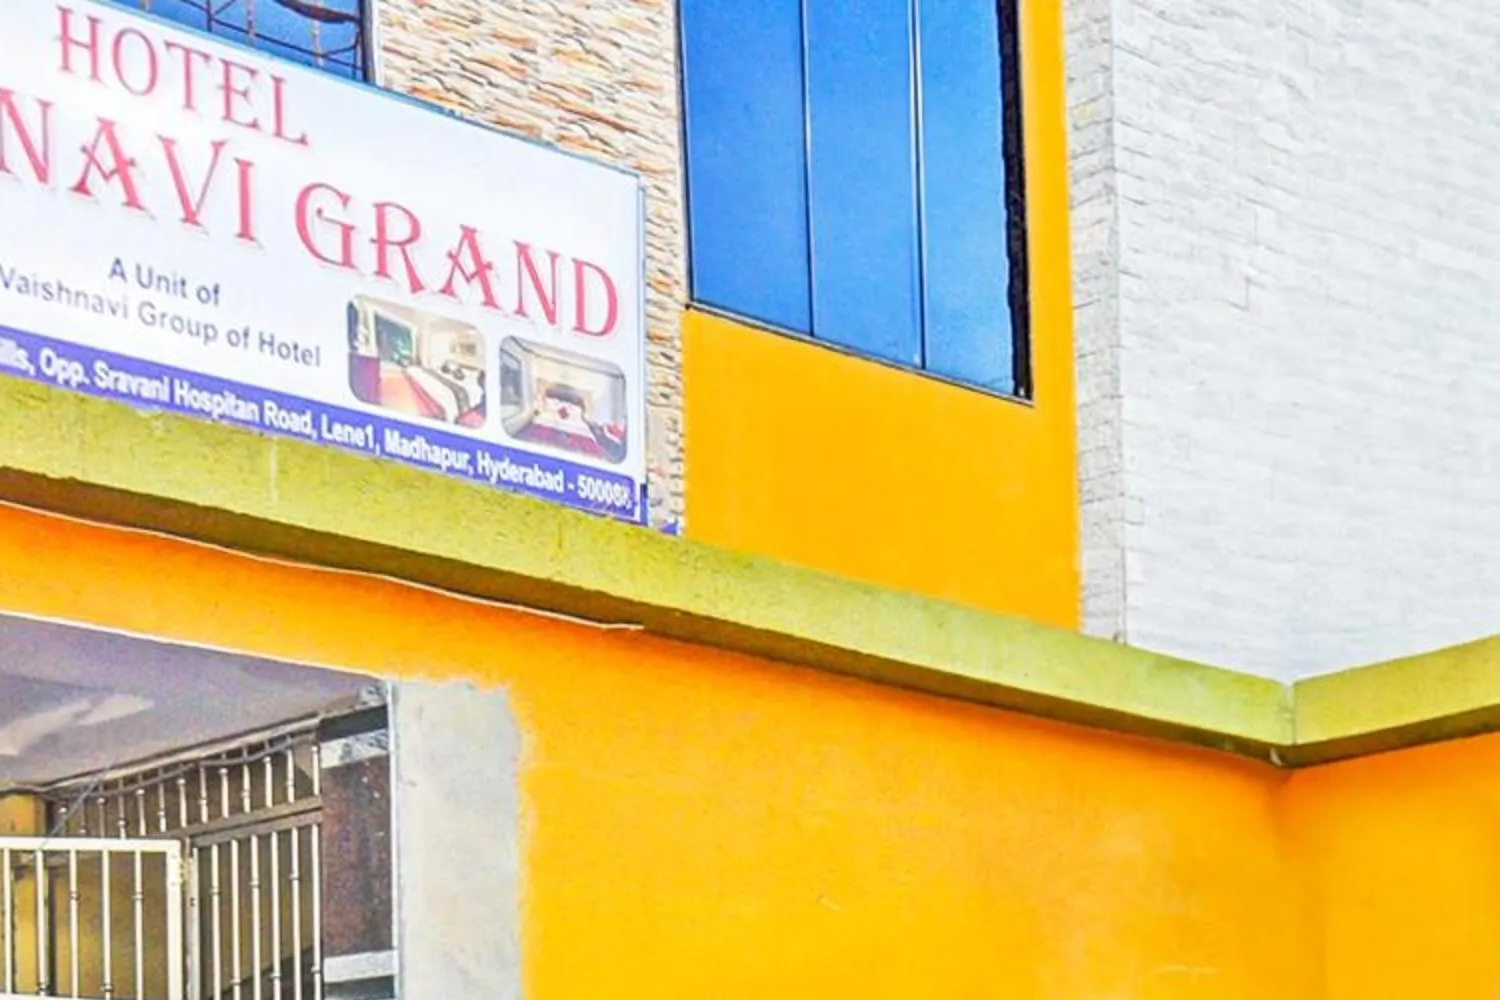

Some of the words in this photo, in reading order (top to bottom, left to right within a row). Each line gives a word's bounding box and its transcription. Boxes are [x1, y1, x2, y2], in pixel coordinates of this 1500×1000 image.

[55, 5, 310, 147] HOTEL
[108, 256, 127, 284] A
[135, 262, 189, 300] Unit
[195, 282, 221, 306] of
[294, 181, 619, 339] GRAND
[137, 300, 219, 345] Group
[225, 325, 251, 352] of
[258, 331, 321, 368] Hotel
[39, 346, 91, 389] Opp.
[263, 399, 318, 440] Road,
[384, 427, 475, 476] Madhapur,
[477, 449, 565, 494] Hyderabad
